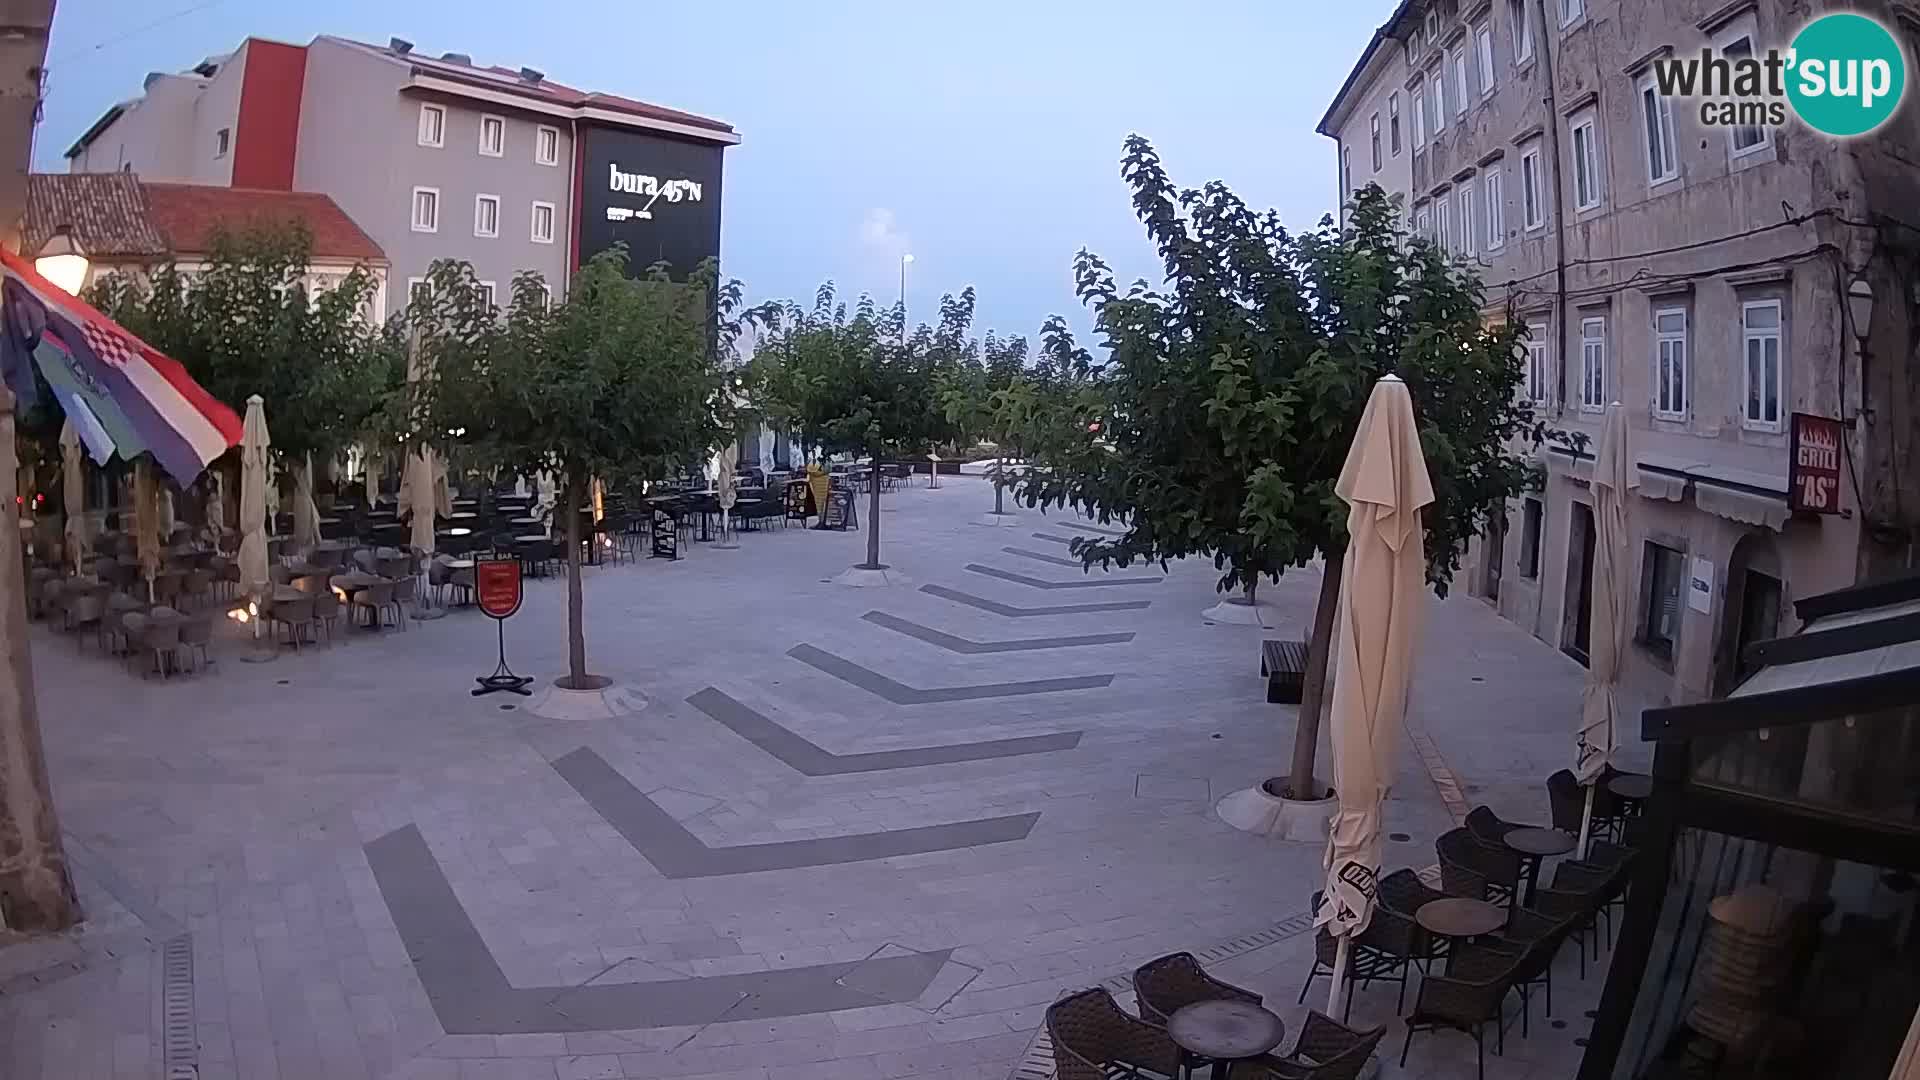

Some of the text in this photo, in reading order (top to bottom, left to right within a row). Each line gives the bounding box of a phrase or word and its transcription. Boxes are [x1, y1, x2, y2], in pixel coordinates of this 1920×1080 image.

[610, 163, 658, 196] bura
[1798, 446, 1837, 470] GRILL
[497, 552, 513, 560] BAR
